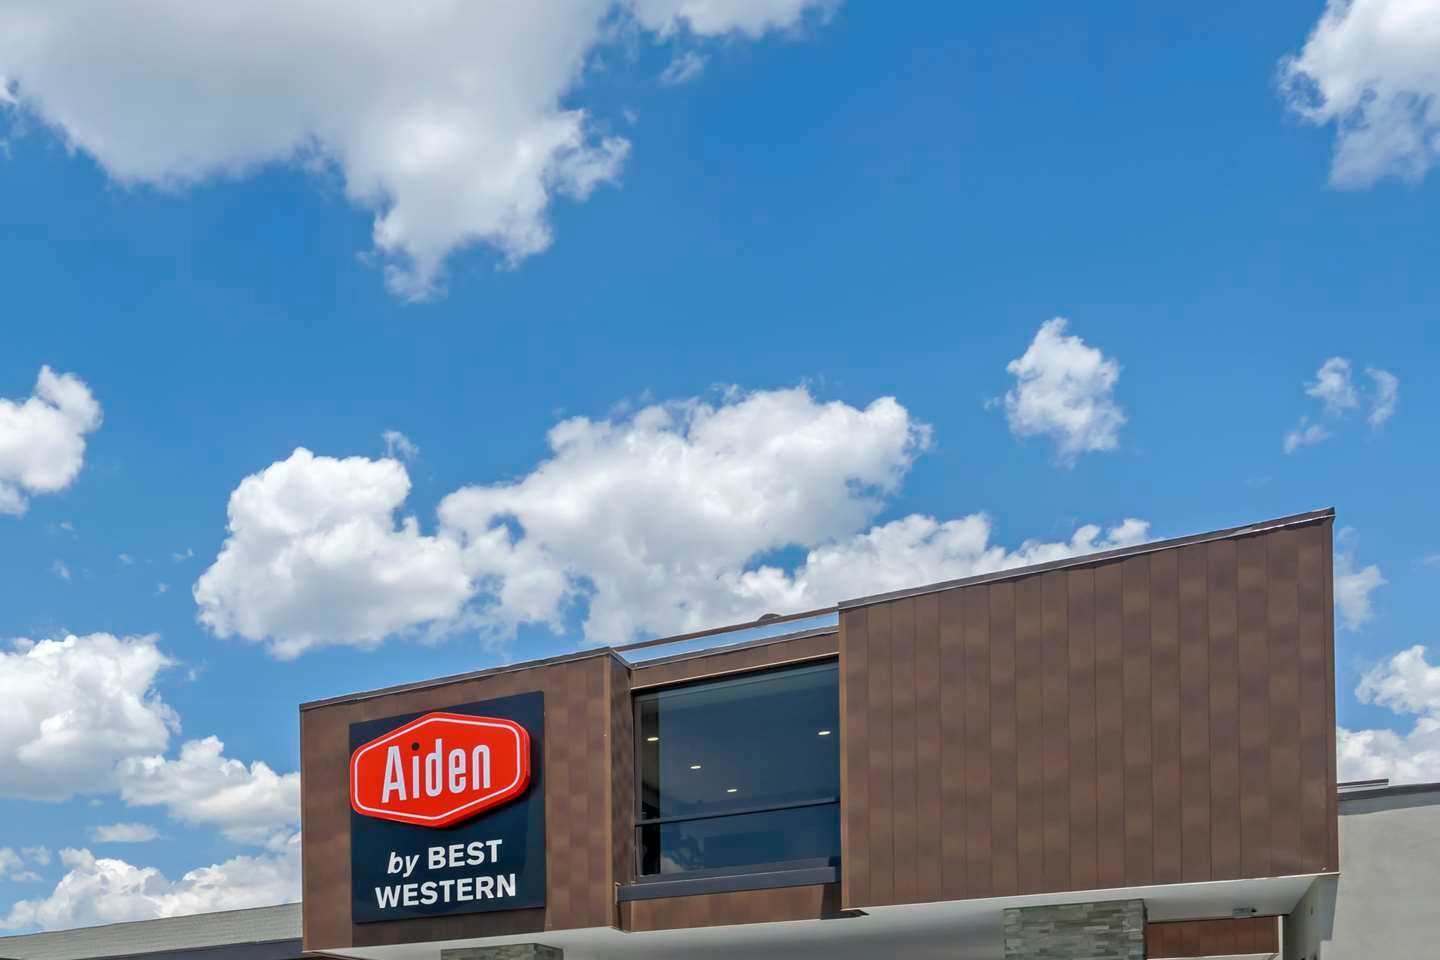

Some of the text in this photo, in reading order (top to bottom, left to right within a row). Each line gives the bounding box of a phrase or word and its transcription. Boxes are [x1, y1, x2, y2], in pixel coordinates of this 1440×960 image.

[381, 738, 491, 803] Aiden
[387, 839, 503, 877] by BEST
[375, 873, 516, 909] WESTERN
